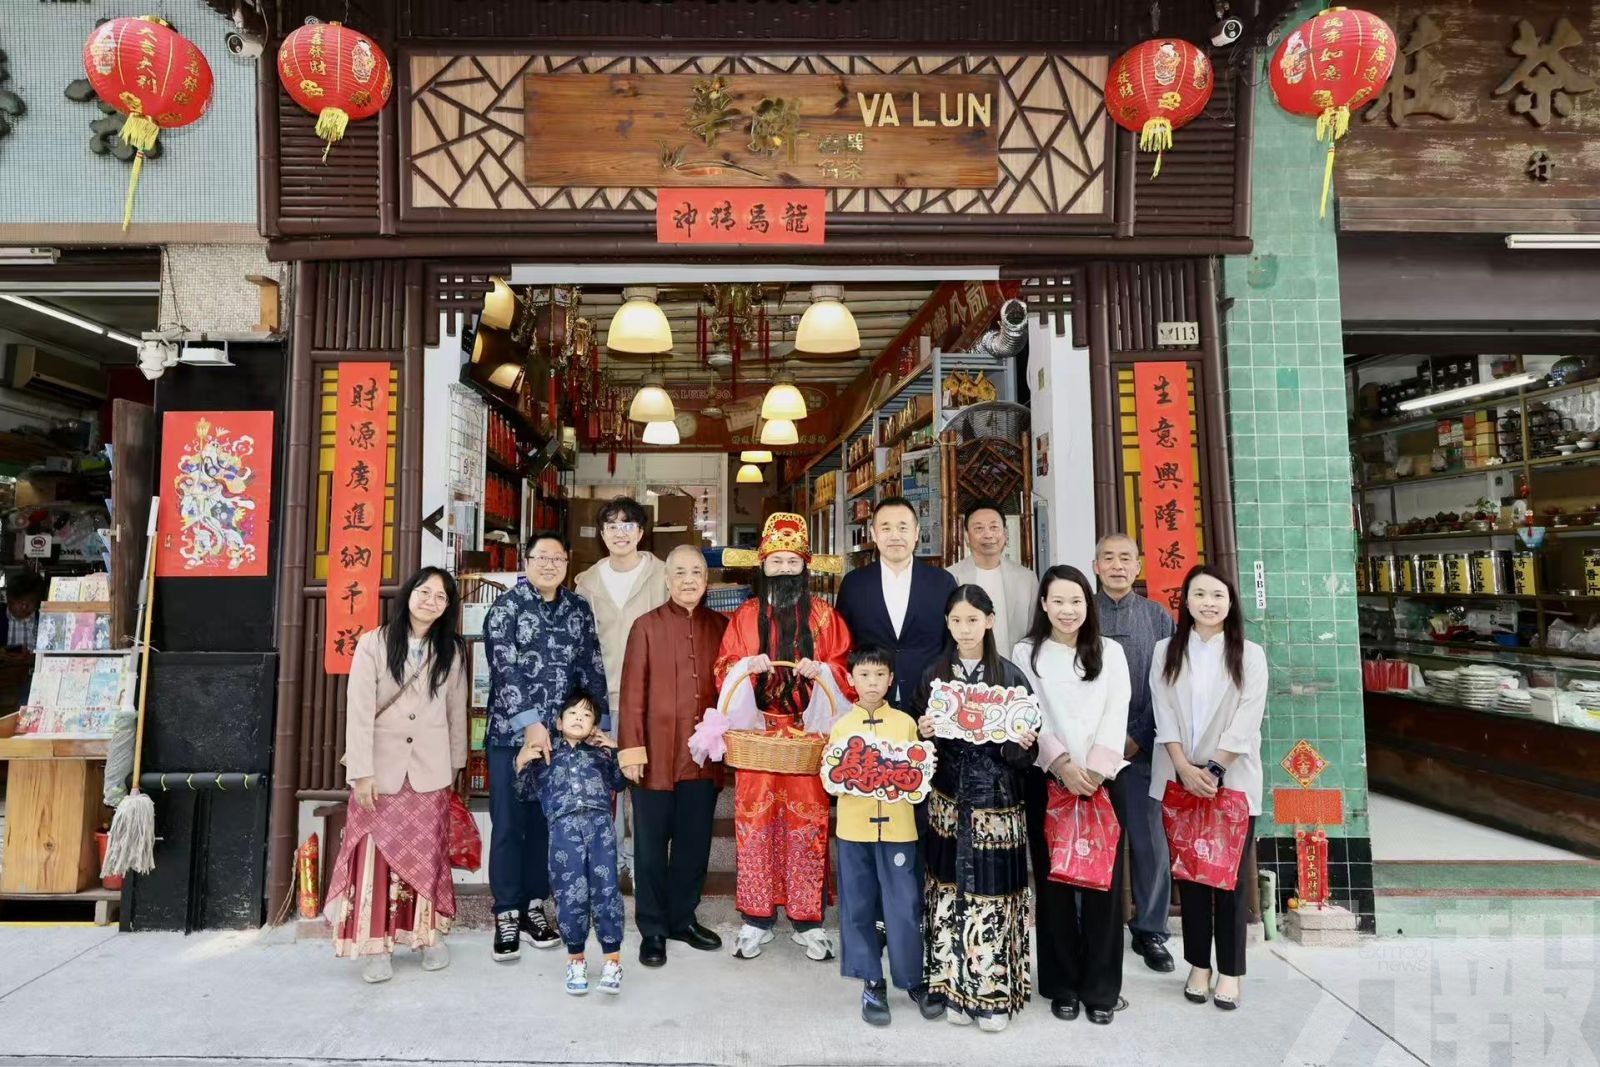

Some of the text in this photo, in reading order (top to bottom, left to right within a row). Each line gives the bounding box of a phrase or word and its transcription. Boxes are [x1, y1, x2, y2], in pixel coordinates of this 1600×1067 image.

[857, 91, 991, 128] VA LUN
[671, 199, 811, 238] 龍馬精神
[1175, 326, 1197, 341] 113
[333, 377, 378, 657] 財源廣進納千祥
